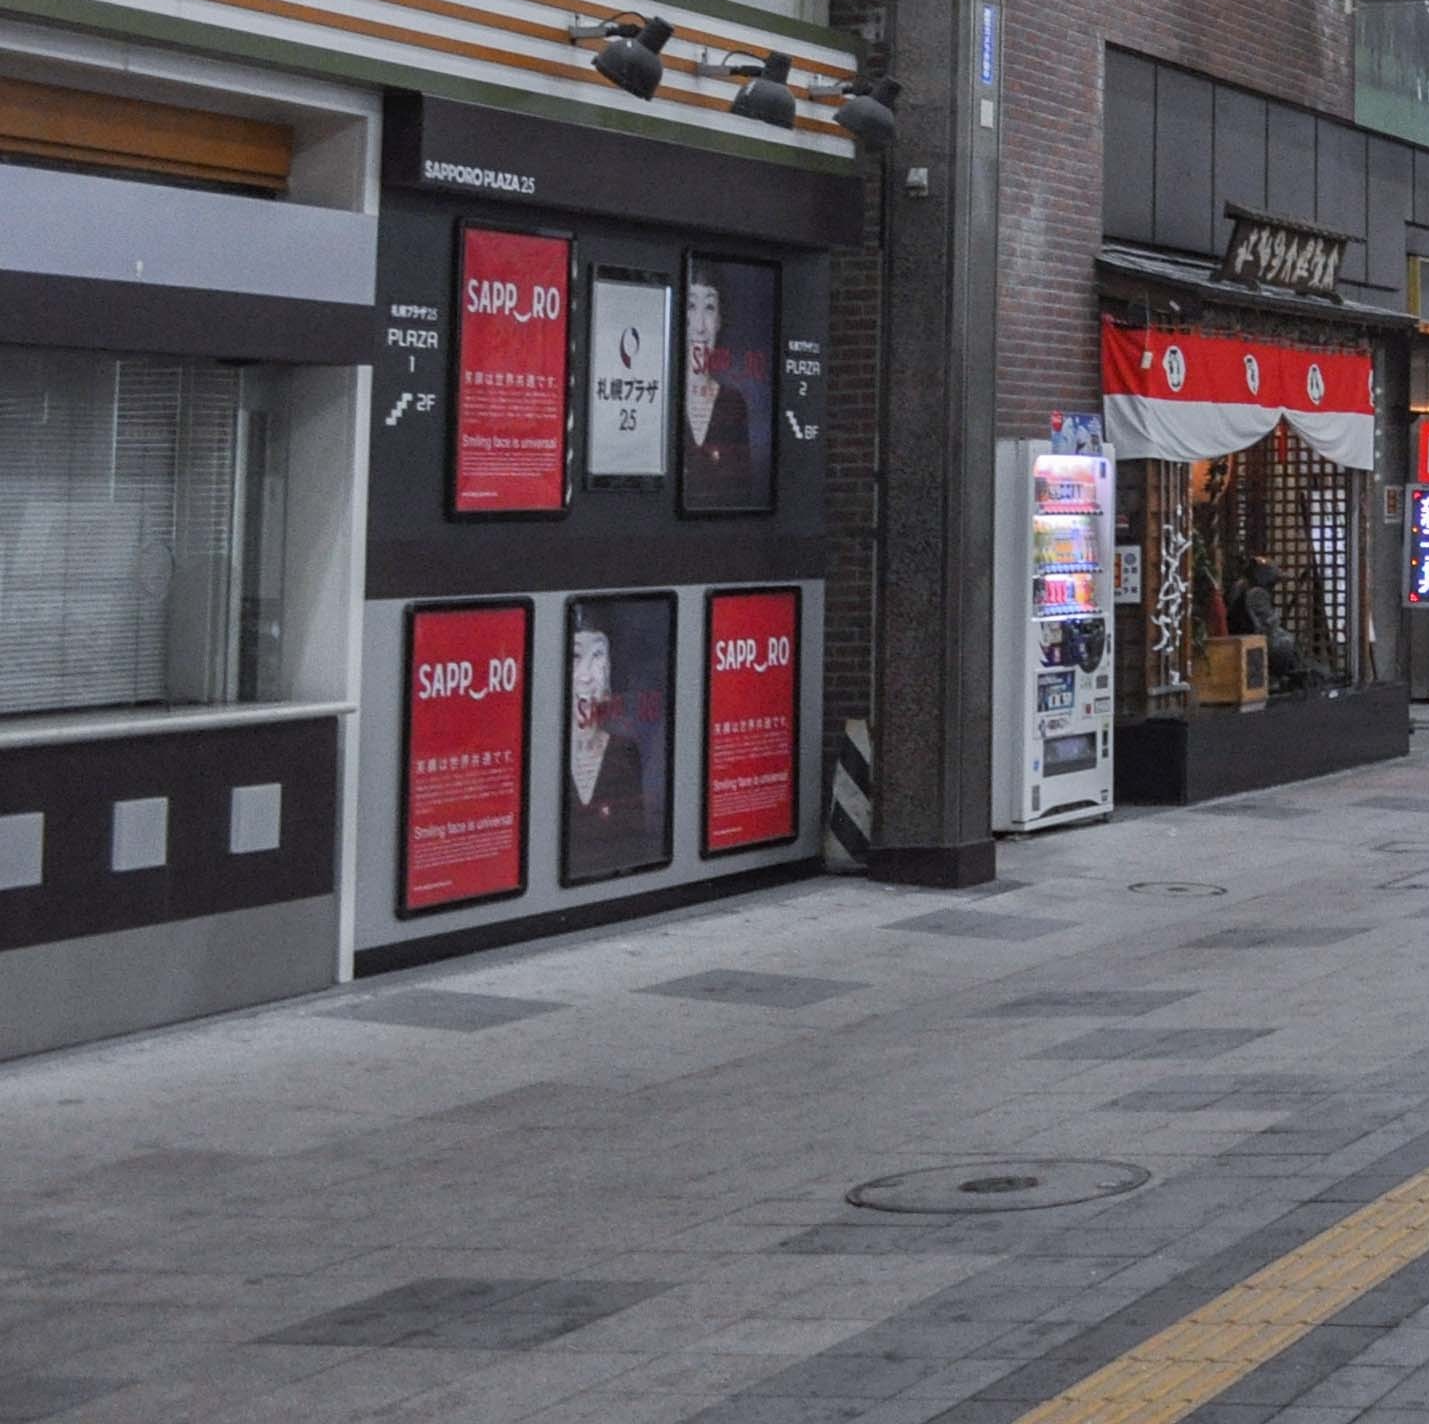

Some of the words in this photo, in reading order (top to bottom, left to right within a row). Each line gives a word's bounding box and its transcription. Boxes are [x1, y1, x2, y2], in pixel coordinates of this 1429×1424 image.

[425, 160, 482, 186] SAPPORO
[484, 169, 520, 192] PLAZA
[388, 328, 438, 349] PLAZA
[786, 359, 821, 375] PLAZA
[416, 393, 436, 411] 2F
[597, 379, 659, 404] 札幌プラザ
